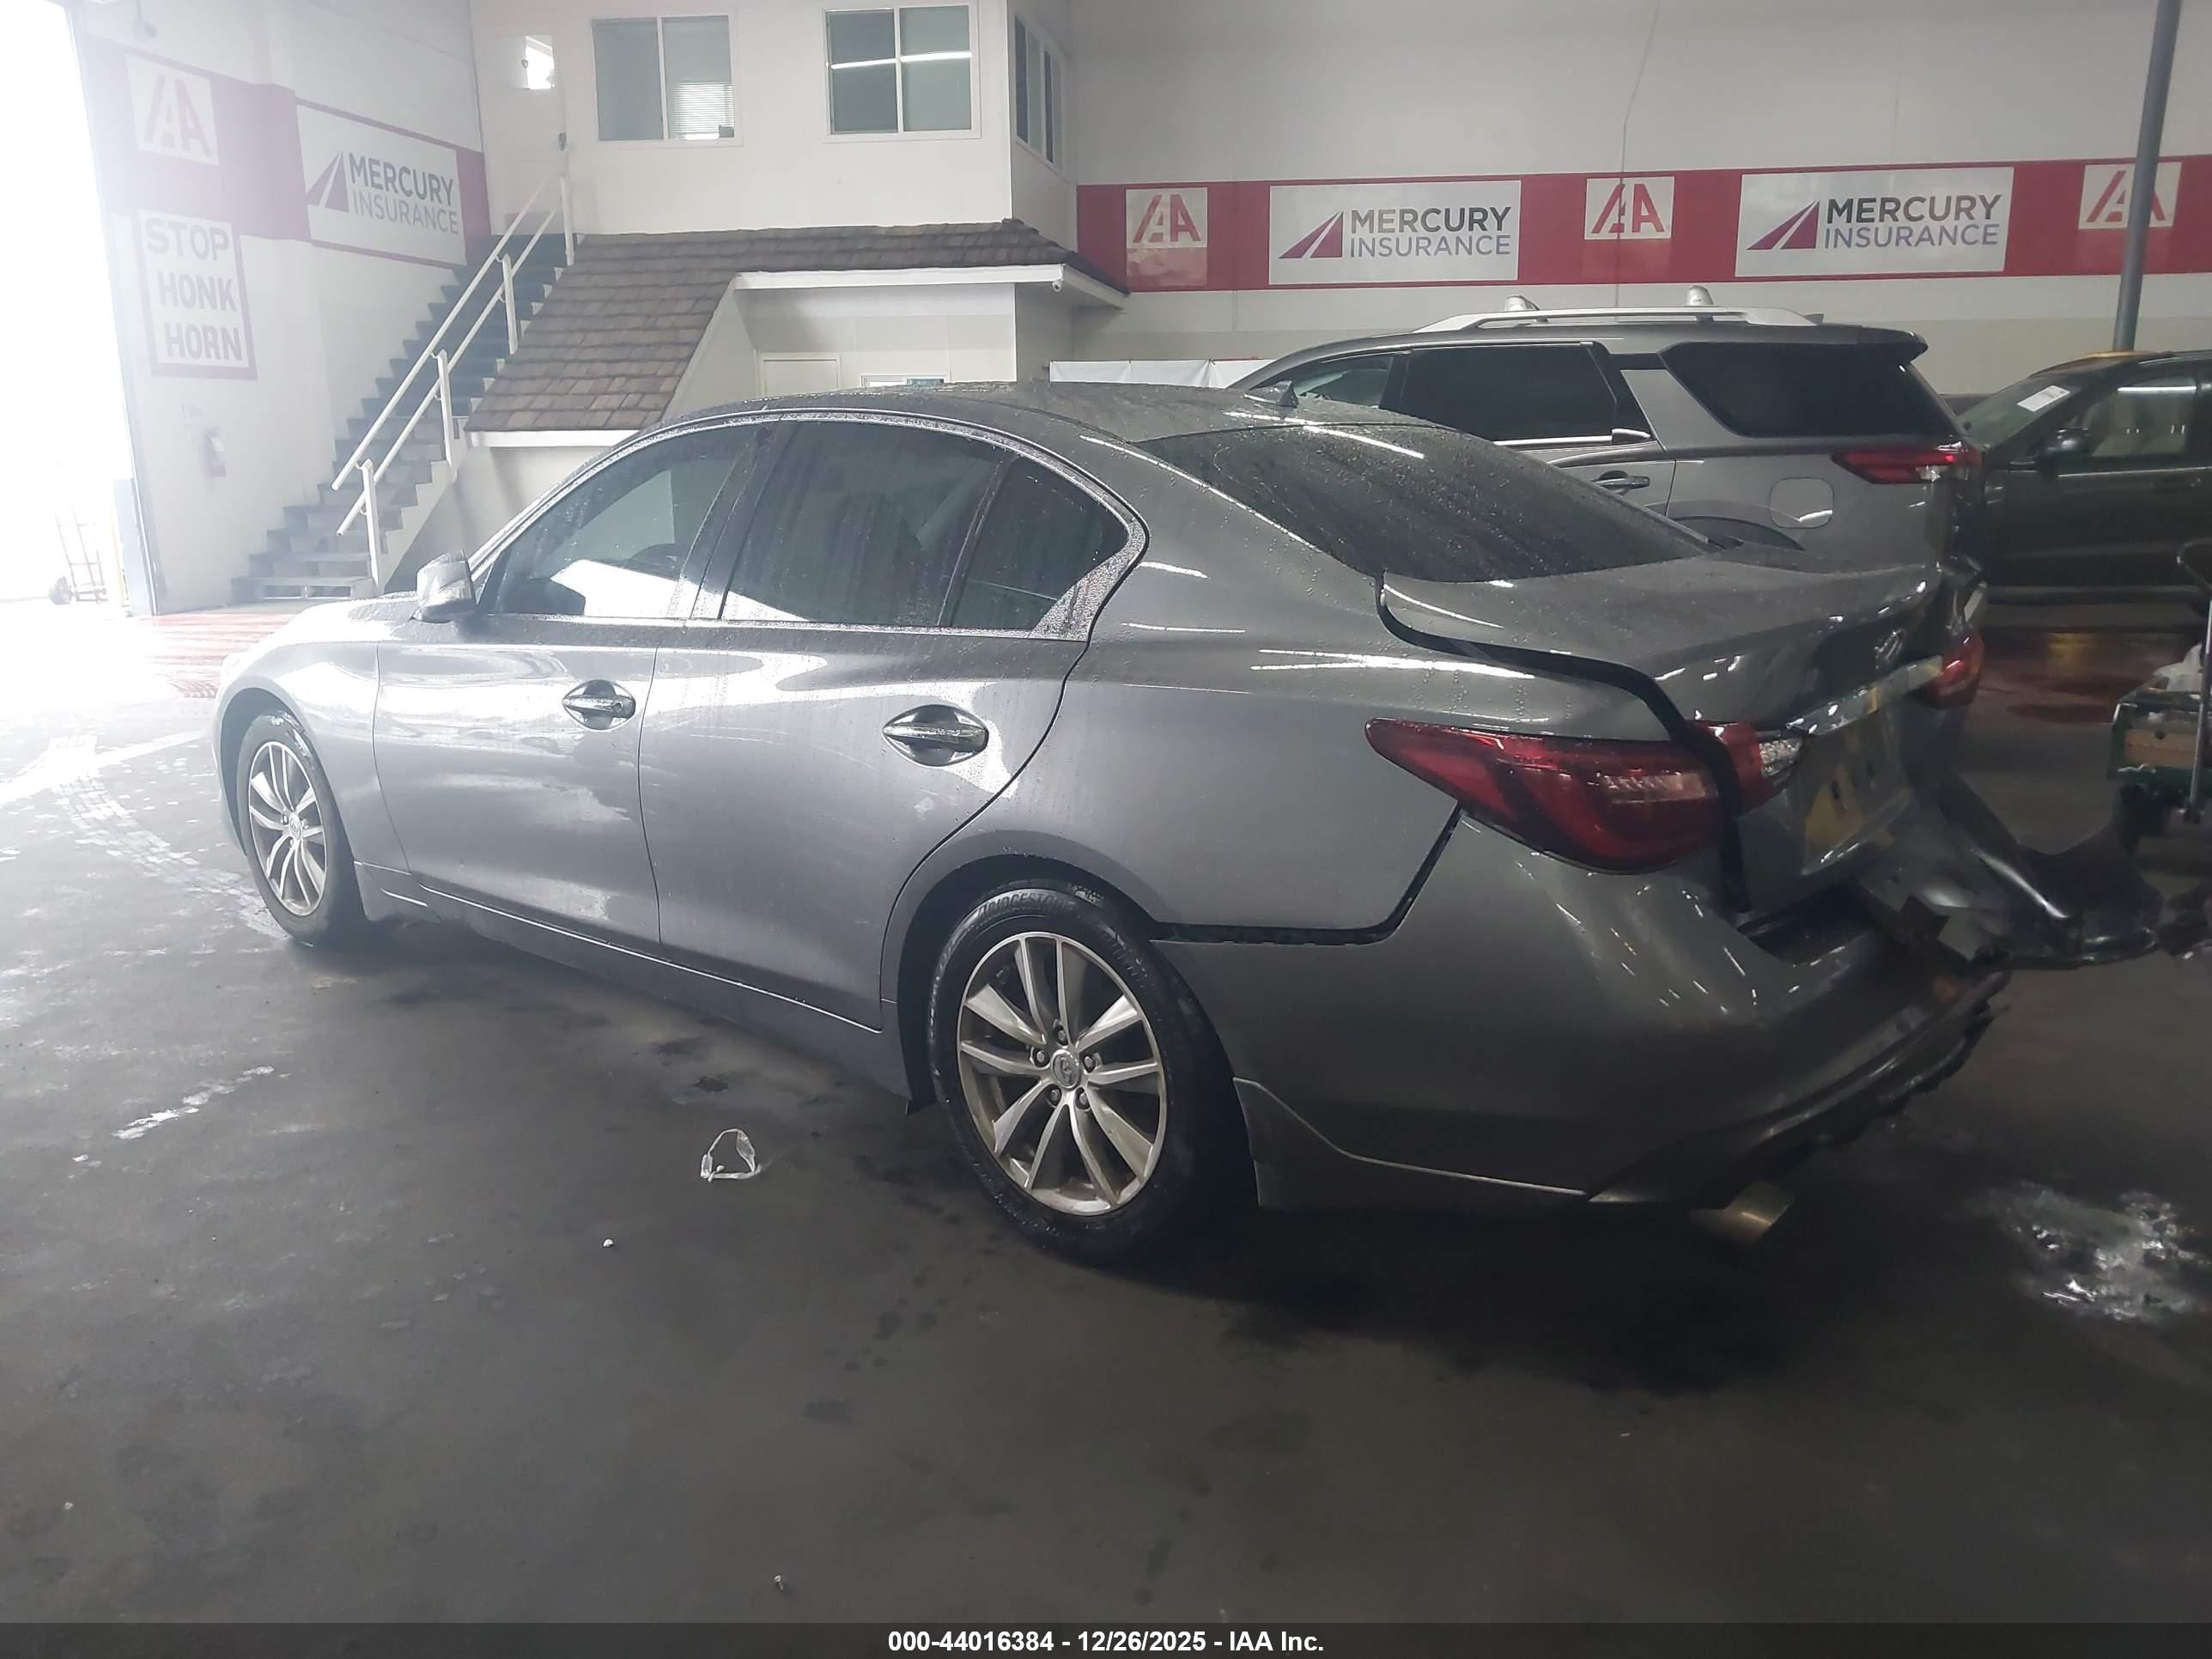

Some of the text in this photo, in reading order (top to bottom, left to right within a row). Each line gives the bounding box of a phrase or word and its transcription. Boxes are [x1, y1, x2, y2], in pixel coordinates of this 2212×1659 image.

[349, 152, 453, 206] MERCURY
[351, 189, 459, 234] INSURANCE
[1351, 206, 1511, 234] MERCURY
[1826, 194, 2002, 224] MERCURY
[145, 217, 230, 261] STOP
[1351, 234, 1511, 258] INSURANCE
[1825, 223, 2000, 248] INSURANCE
[158, 270, 238, 312] HONK
[163, 321, 243, 361] HORN
